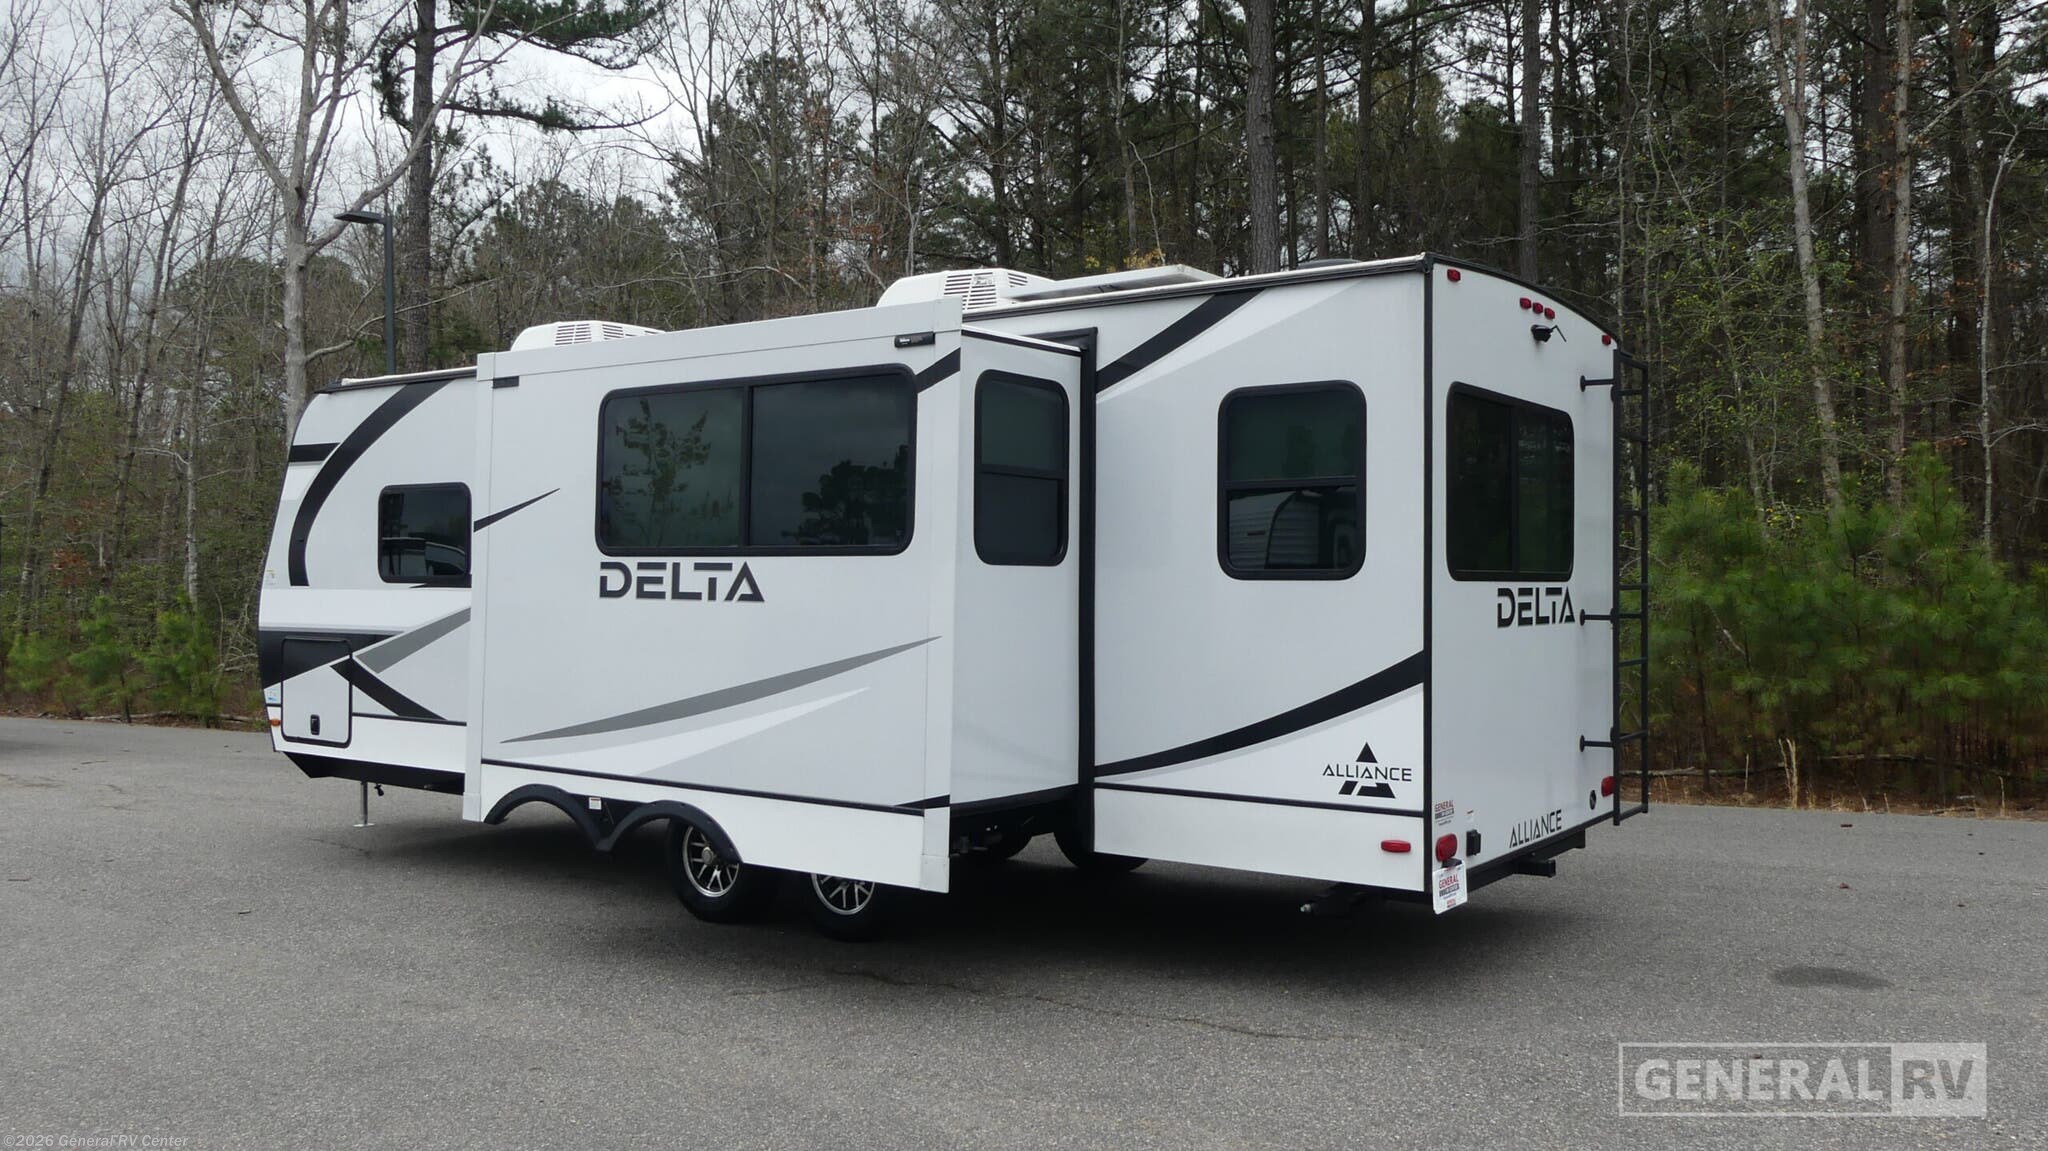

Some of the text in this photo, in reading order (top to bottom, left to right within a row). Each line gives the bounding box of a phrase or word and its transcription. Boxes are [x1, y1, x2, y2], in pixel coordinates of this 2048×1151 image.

[600, 561, 765, 602] DELTA
[1497, 586, 1575, 628] DELTA
[1322, 763, 1412, 782] ALLIANCE
[1509, 809, 1562, 848] ALLIANCE
